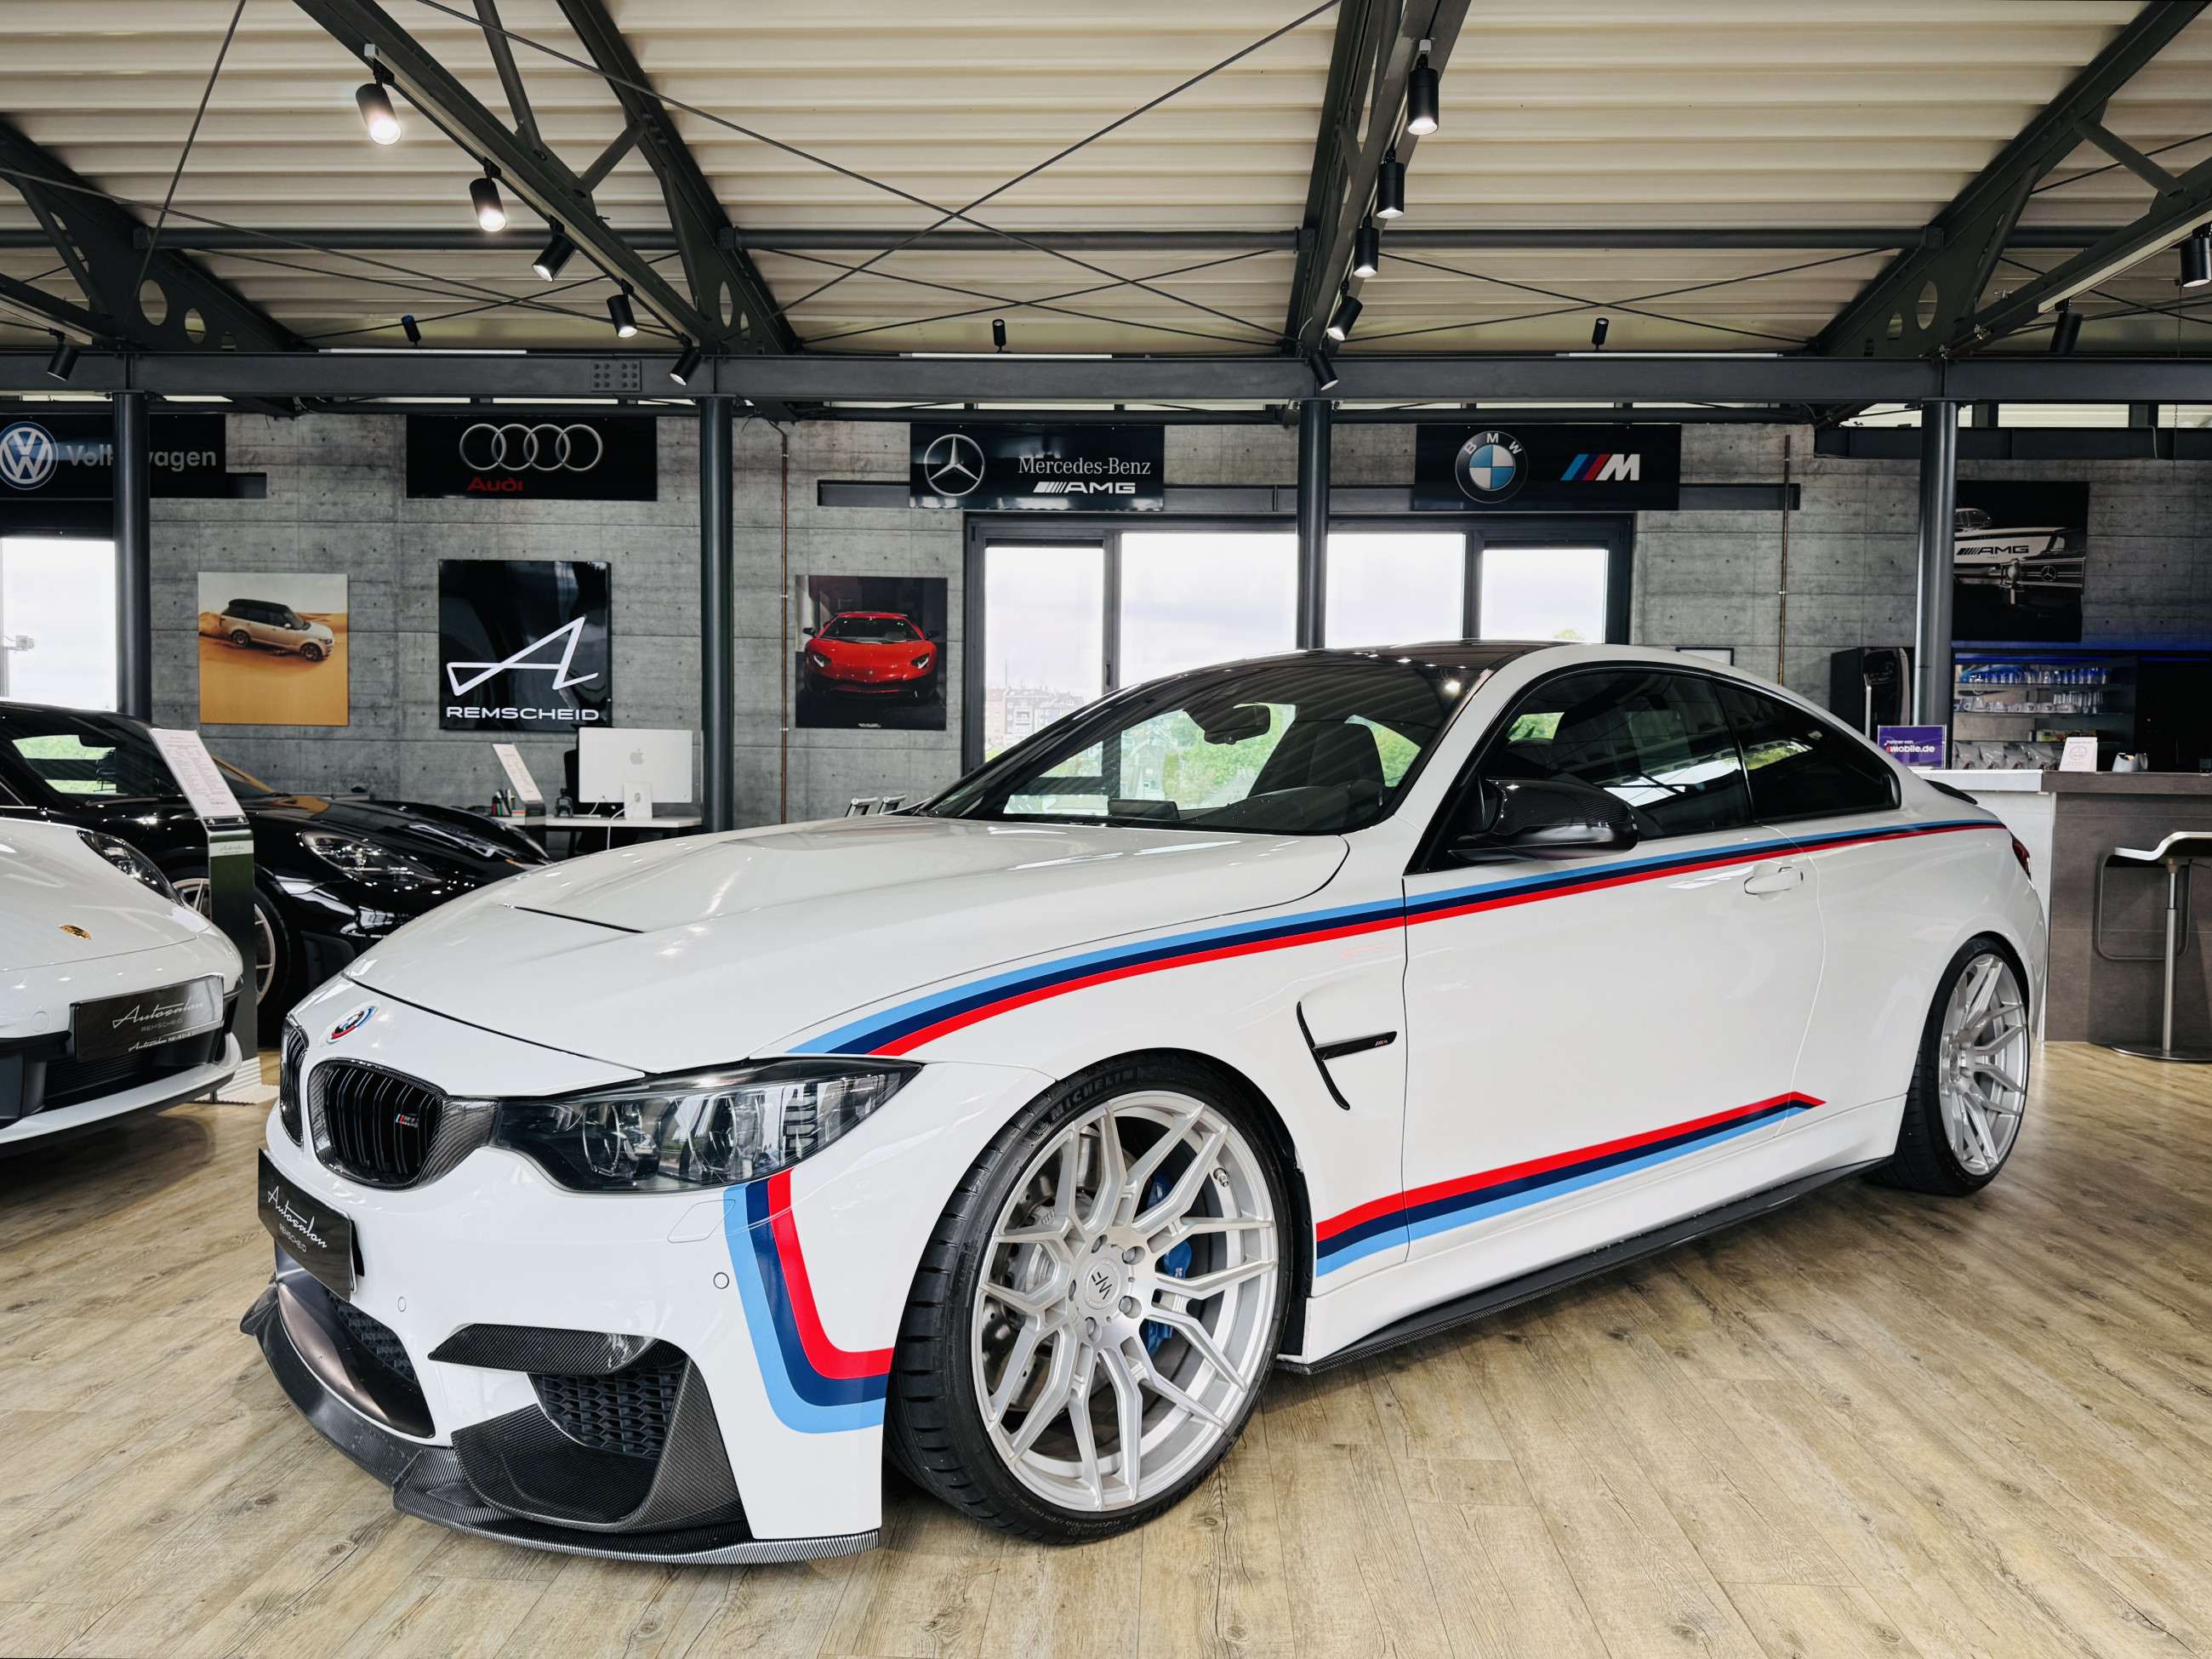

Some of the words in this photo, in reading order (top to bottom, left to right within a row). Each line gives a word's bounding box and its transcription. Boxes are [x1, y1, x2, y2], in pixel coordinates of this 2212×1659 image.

[1018, 456, 1151, 475] Mercedes-Benz
[465, 476, 525, 492] Audi
[1063, 482, 1137, 494] AMG
[446, 706, 600, 721] REMSCHEID
[112, 995, 204, 1029] Autosalon
[267, 1185, 328, 1249] Autosalon
